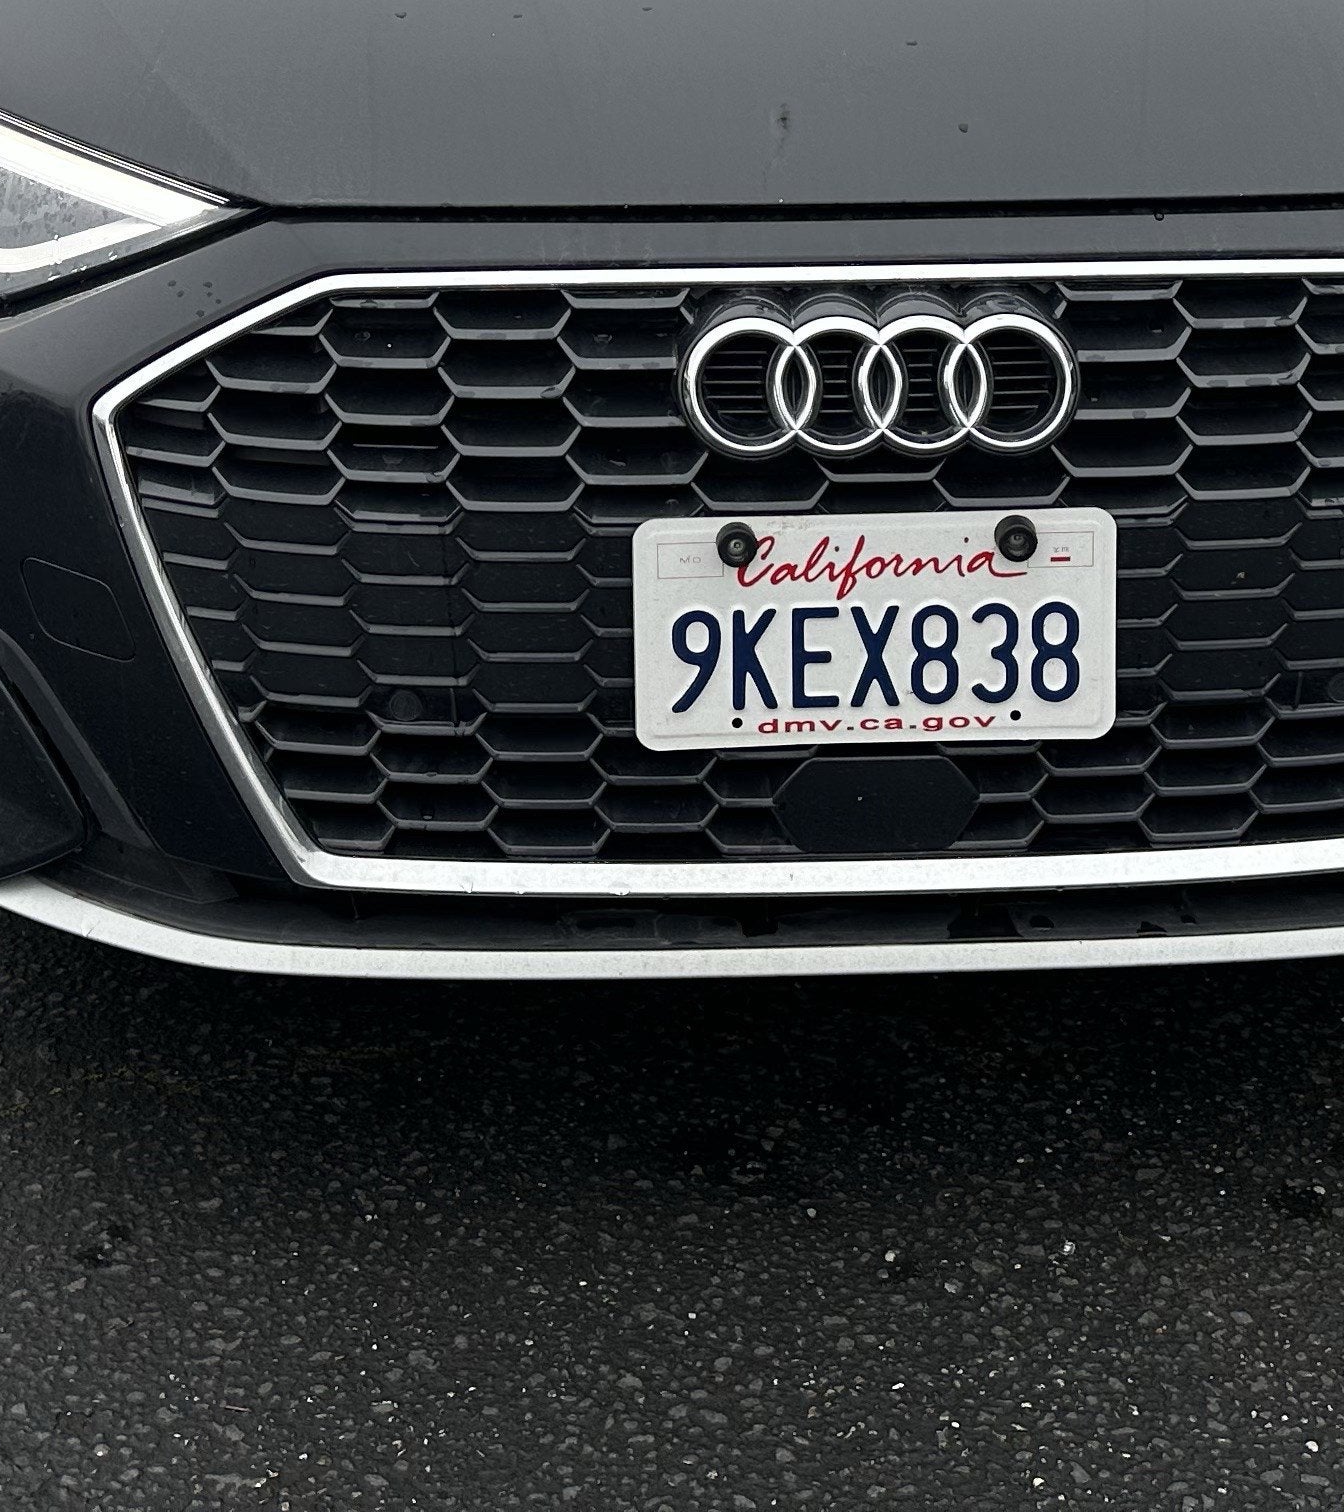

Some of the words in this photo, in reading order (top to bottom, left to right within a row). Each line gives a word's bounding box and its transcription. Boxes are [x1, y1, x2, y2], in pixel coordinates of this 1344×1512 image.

[737, 534, 1027, 601] California
[671, 602, 1080, 714] 9KEX838
[757, 715, 996, 734] dmv.ca.gov
